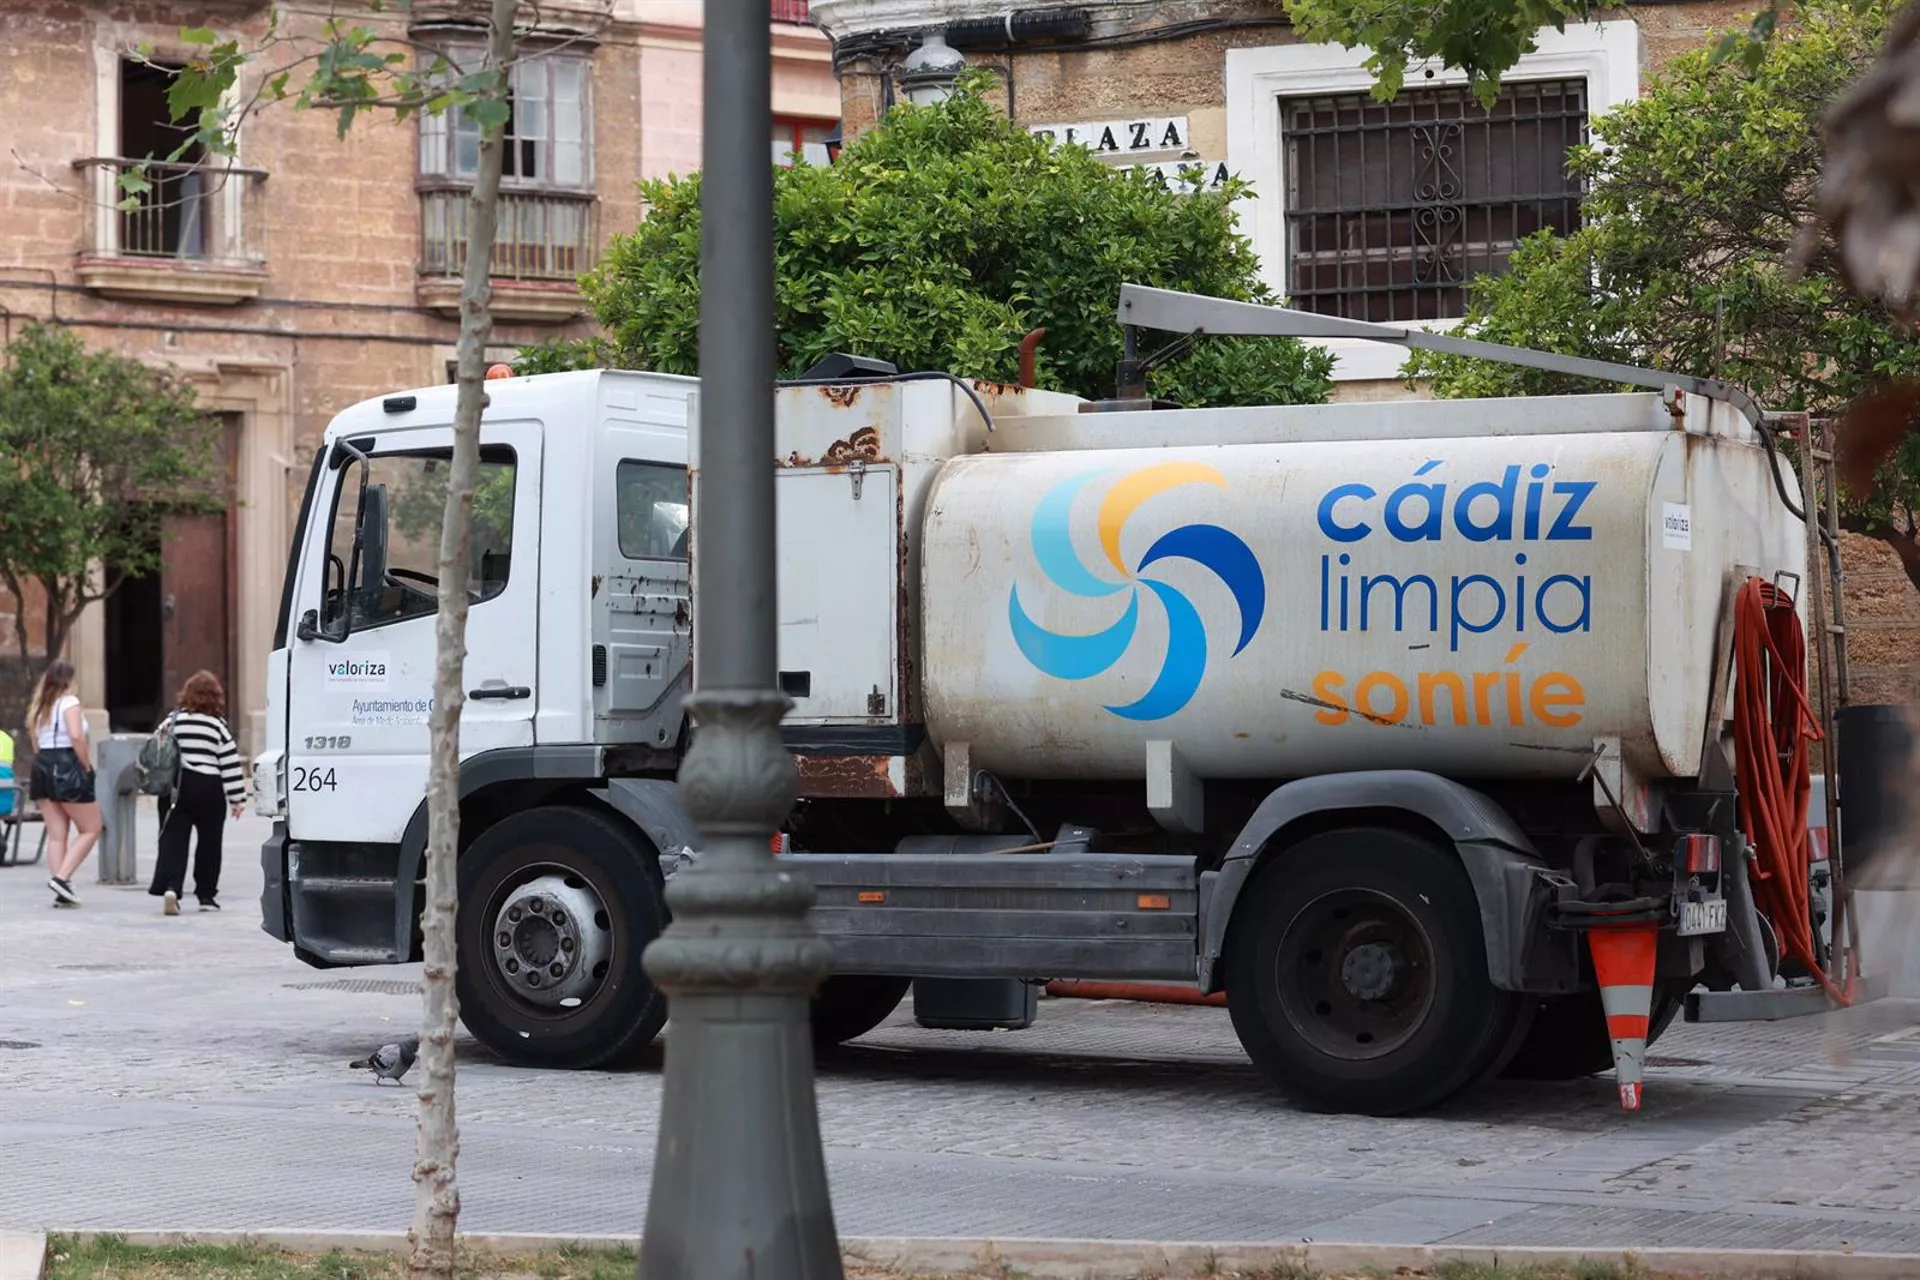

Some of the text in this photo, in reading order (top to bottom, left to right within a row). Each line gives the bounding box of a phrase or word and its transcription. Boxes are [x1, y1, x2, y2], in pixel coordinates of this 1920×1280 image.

[1034, 121, 1182, 150] PLAZA
[1317, 460, 1597, 542] cádiz
[1321, 553, 1591, 652] limpia
[328, 660, 386, 676] valoriza
[1312, 643, 1586, 727] sonríe
[352, 699, 413, 714] Ayuntamiento
[415, 699, 427, 712] de
[293, 766, 338, 792] 264
